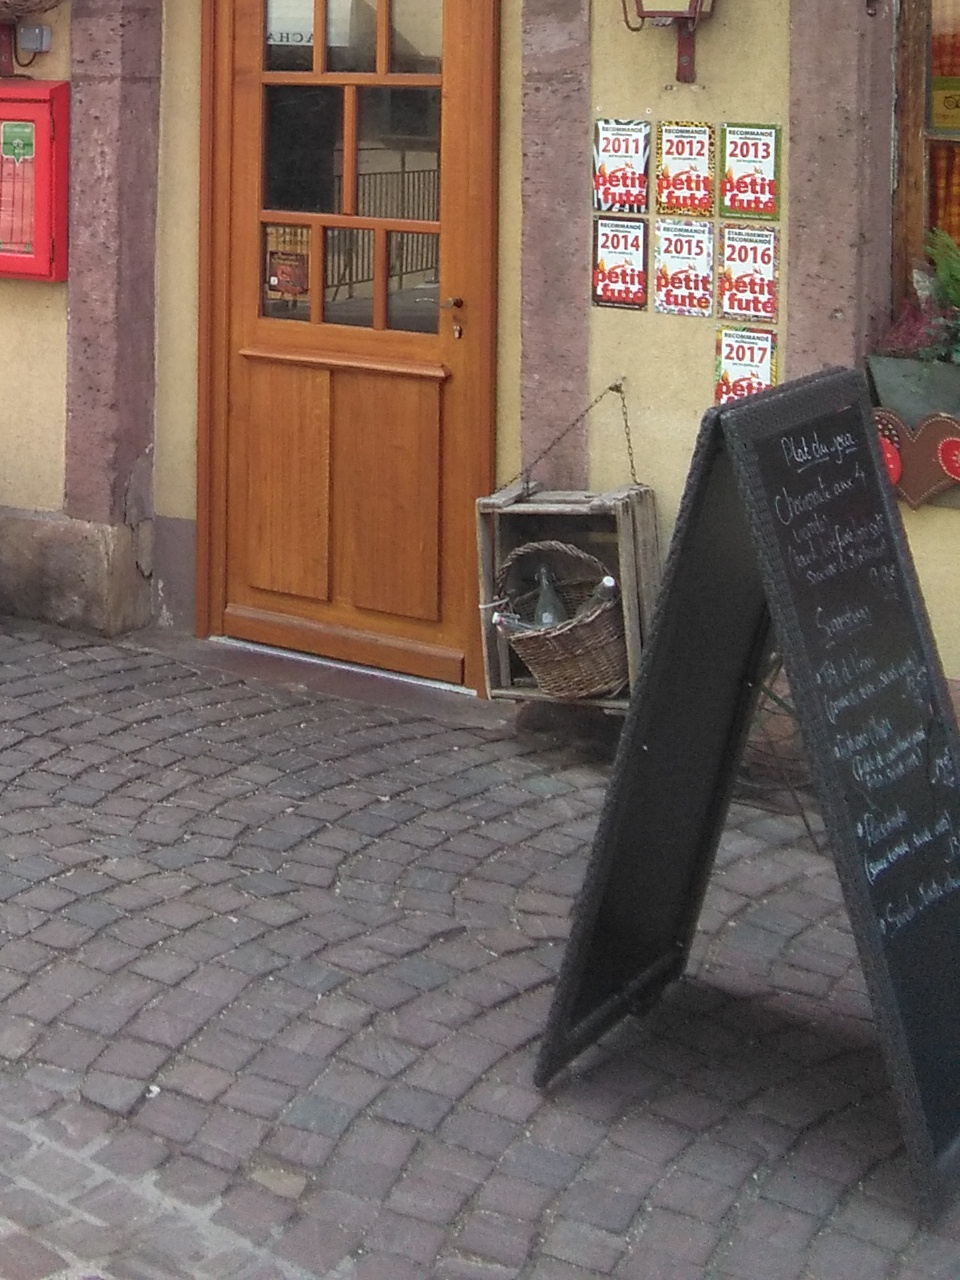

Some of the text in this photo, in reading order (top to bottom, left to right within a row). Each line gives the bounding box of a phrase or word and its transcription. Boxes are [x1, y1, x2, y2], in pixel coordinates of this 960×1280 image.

[602, 137, 640, 154] 2011
[665, 139, 705, 157] 2012
[729, 141, 771, 159] 2013
[594, 171, 646, 190] petit
[658, 174, 711, 193] petit
[721, 177, 777, 196] petit
[602, 187, 646, 205] futé
[666, 191, 711, 209] futé
[729, 193, 776, 213] futé
[601, 233, 640, 251] 2014
[664, 238, 704, 256] 2015
[726, 244, 772, 265] 2016
[593, 268, 646, 287] petit
[656, 273, 710, 292] petit
[719, 277, 776, 297] petit
[602, 284, 646, 304] futé
[665, 289, 711, 309] futé
[728, 293, 776, 313] futé
[724, 343, 768, 364] 2017
[781, 435, 812, 467] Plat
[812, 431, 829, 458] du
